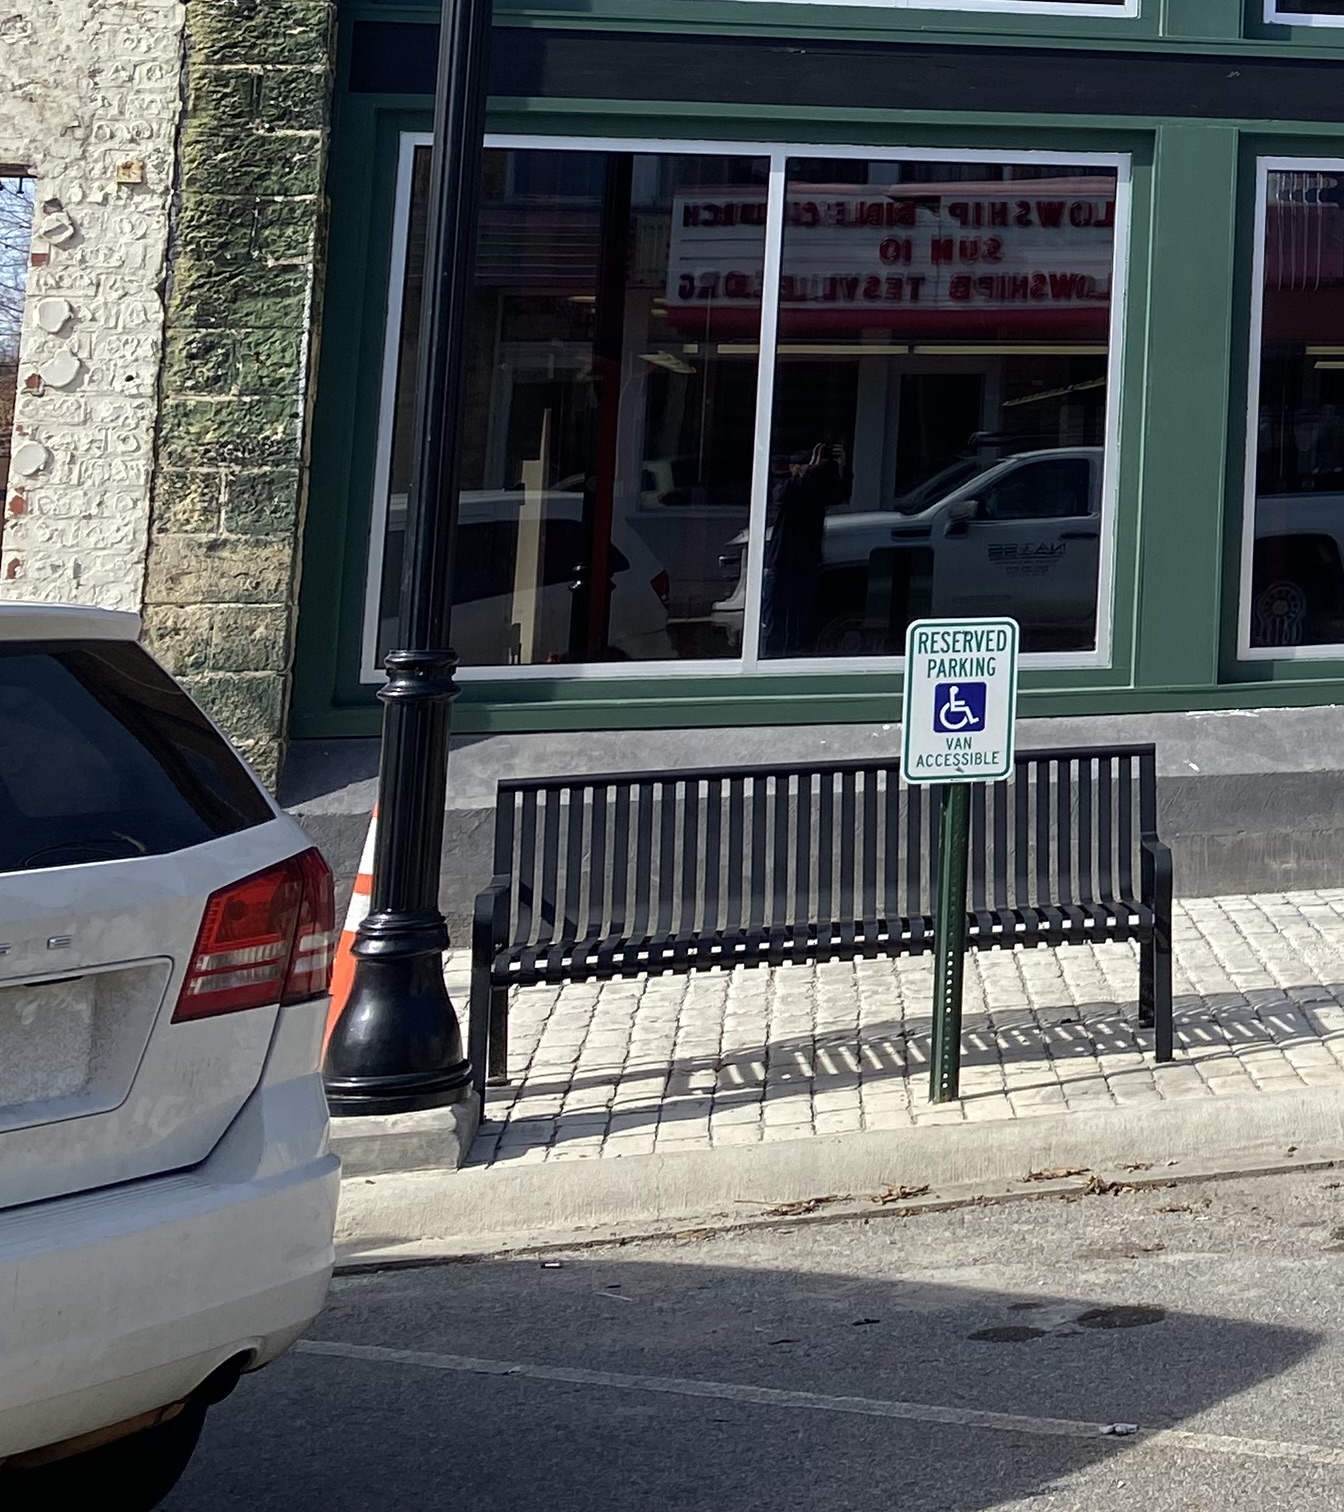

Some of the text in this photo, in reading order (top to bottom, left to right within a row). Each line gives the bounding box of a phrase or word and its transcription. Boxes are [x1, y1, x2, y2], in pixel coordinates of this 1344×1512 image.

[917, 629, 1008, 654] RESERVED
[927, 656, 997, 678] PARKING
[945, 736, 973, 750] VAN
[916, 750, 1000, 768] ACCESSIBLE
